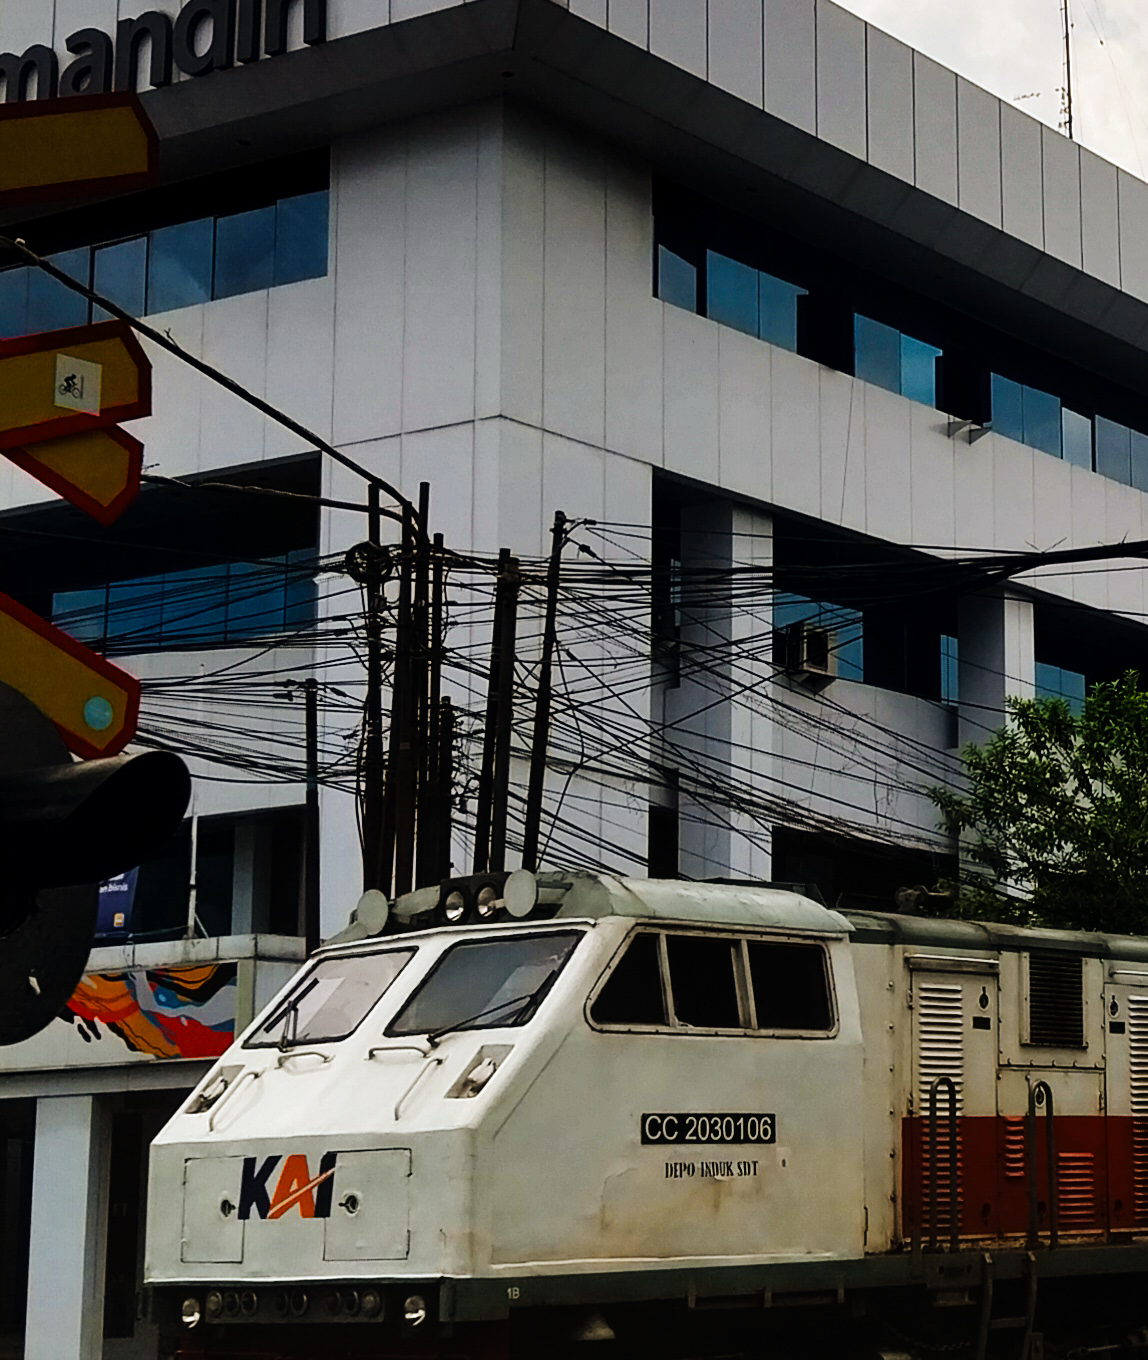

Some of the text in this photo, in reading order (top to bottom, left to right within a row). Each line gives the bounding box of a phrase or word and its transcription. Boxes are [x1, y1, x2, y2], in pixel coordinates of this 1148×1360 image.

[645, 1115, 772, 1141] CC 2030106
[664, 1160, 759, 1179] DEPO INDUK SDT
[237, 1153, 338, 1220] KAI
[506, 1286, 520, 1300] 1B
